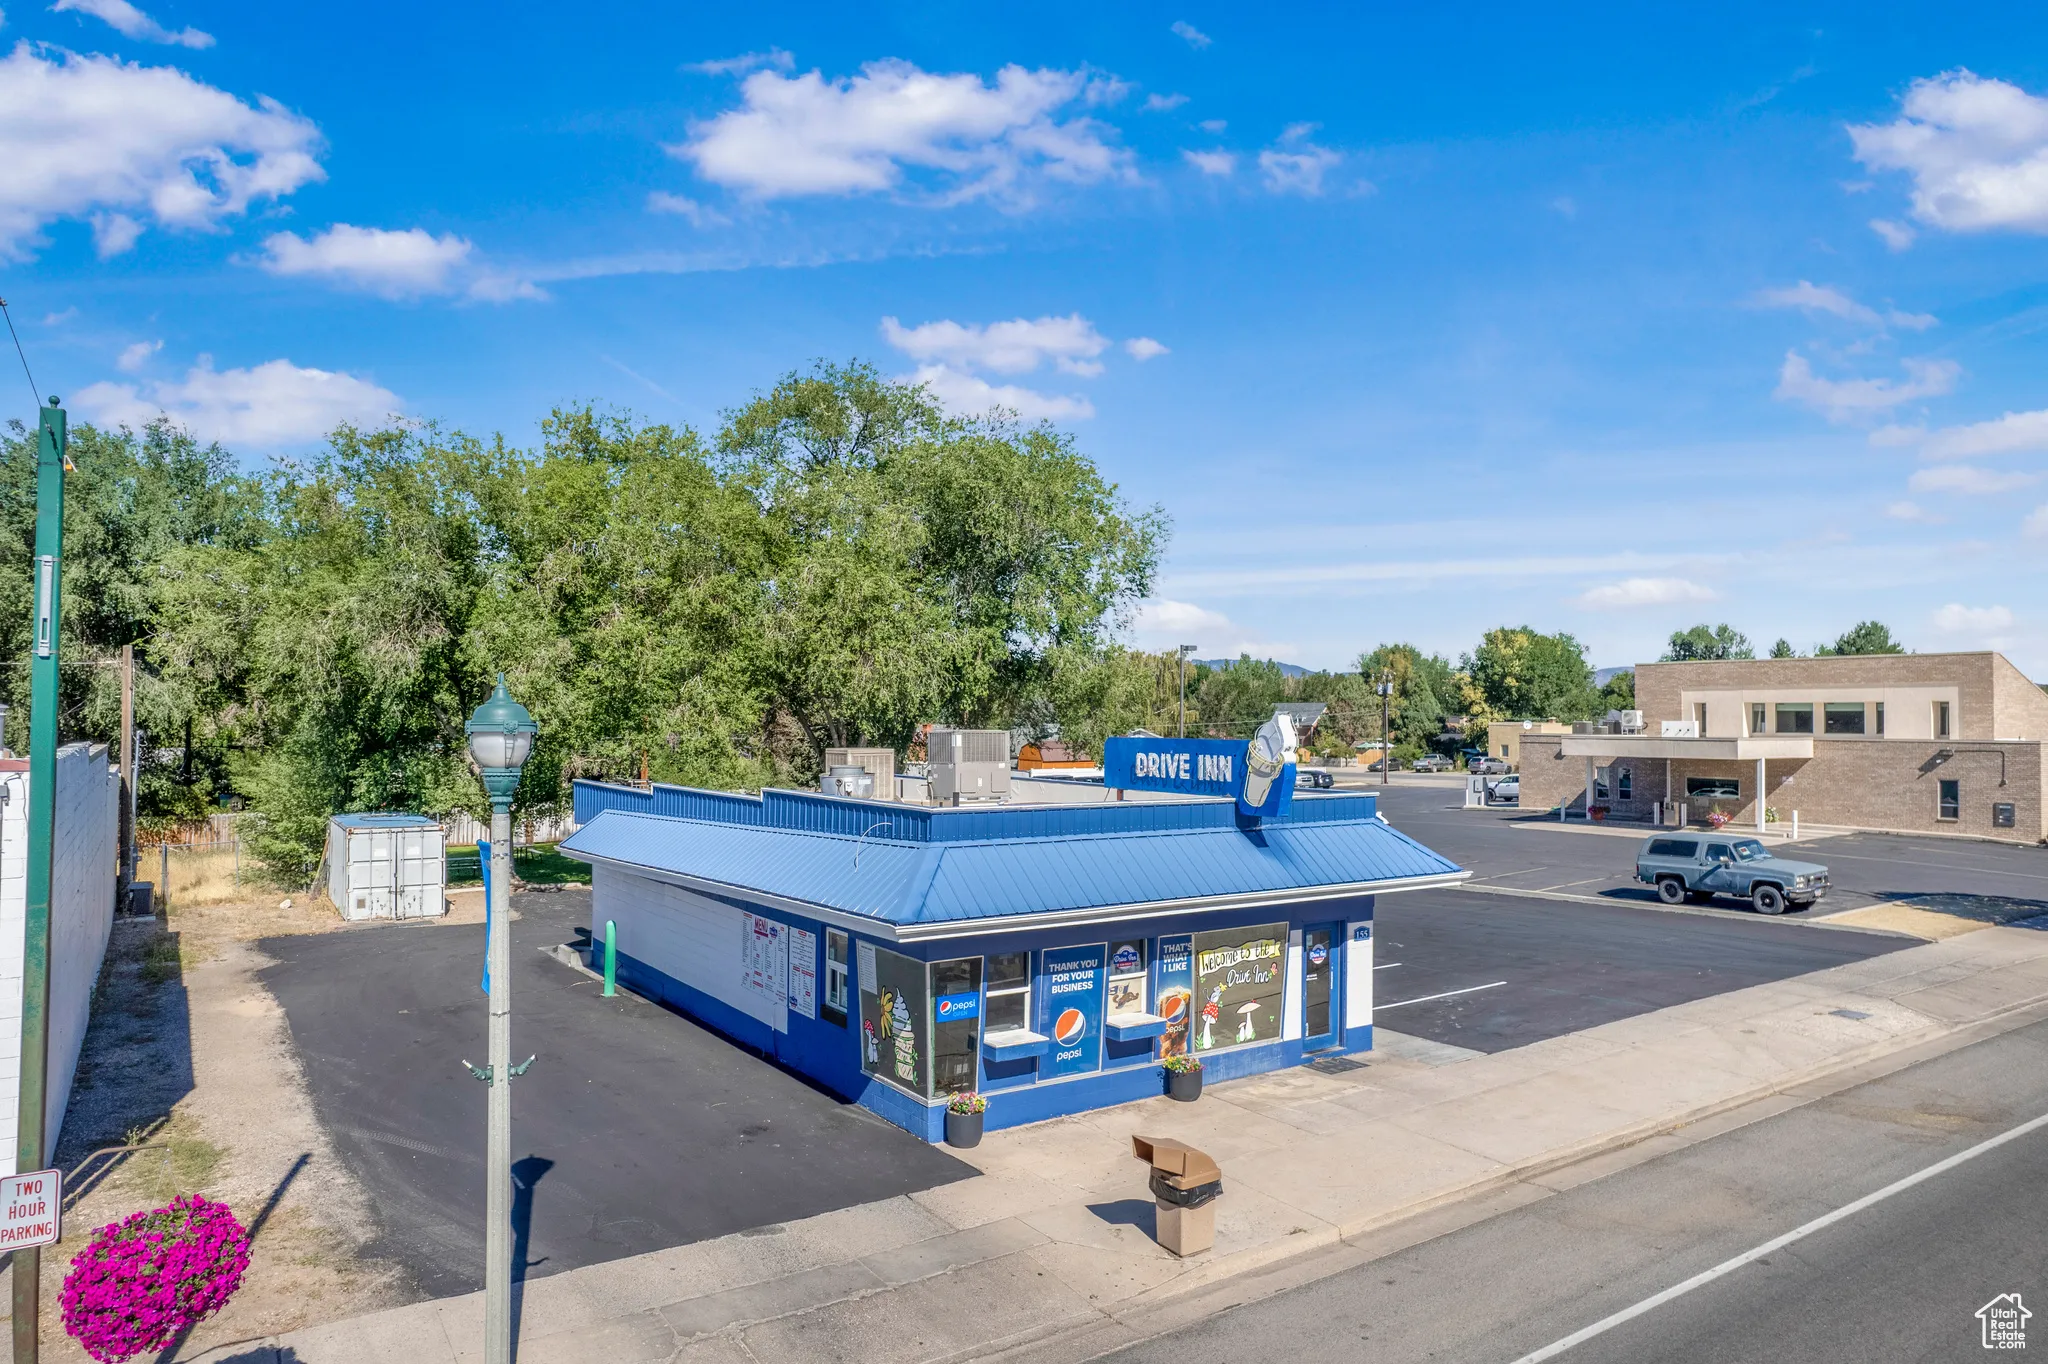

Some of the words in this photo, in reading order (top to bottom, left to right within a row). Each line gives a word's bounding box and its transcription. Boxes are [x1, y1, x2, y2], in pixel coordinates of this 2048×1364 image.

[1135, 752, 1190, 780] DRIVE
[1197, 753, 1232, 782] INN
[1356, 930, 1368, 939] 155
[1163, 942, 1192, 954] THAT'S
[1163, 952, 1188, 963] WHAT
[1201, 949, 1238, 972] Welcome
[1240, 948, 1251, 959] to
[1255, 941, 1270, 957] the
[1049, 961, 1079, 973] THANK
[1080, 959, 1098, 968] YOU
[1163, 964, 1166, 973] I
[1168, 962, 1187, 972] LIKE
[1052, 973, 1069, 983] FOR
[1070, 970, 1094, 981] YOUR
[1226, 968, 1251, 988] Drive
[1253, 964, 1269, 984] Inn
[1051, 981, 1094, 994] BUSINESS
[952, 999, 976, 1011] pepsi
[1056, 1047, 1082, 1062] pepsi
[15, 1180, 43, 1196] TWO
[8, 1202, 46, 1219] HOUR
[1, 1221, 52, 1243] PARKING
